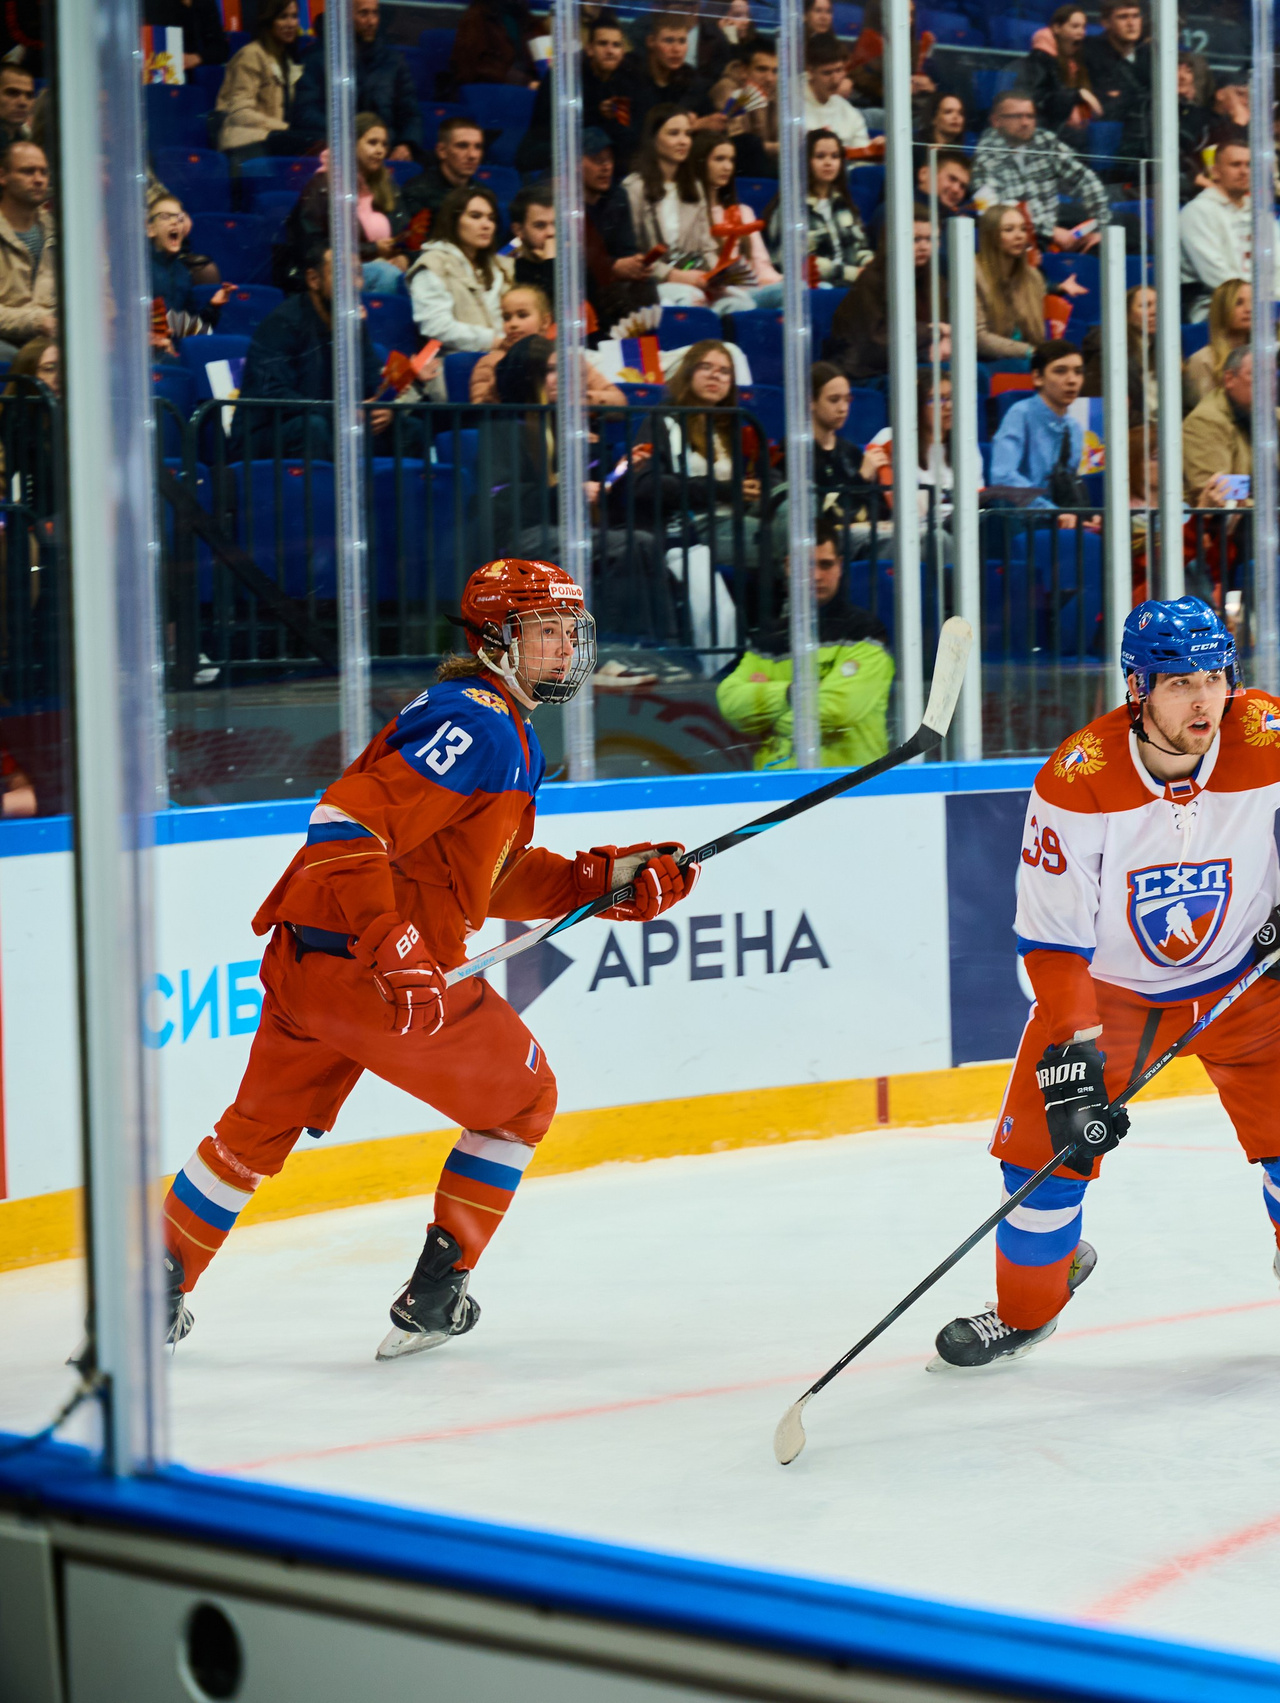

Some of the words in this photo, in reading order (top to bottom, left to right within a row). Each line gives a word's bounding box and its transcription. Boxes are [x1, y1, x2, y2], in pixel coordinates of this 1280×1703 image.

[551, 586, 582, 597] РОЛЬФ
[1190, 642, 1219, 652] CCM
[414, 720, 474, 776] 13
[1021, 814, 1068, 876] 39
[1134, 864, 1226, 902] СХЛ
[587, 908, 831, 992] АРЕНА
